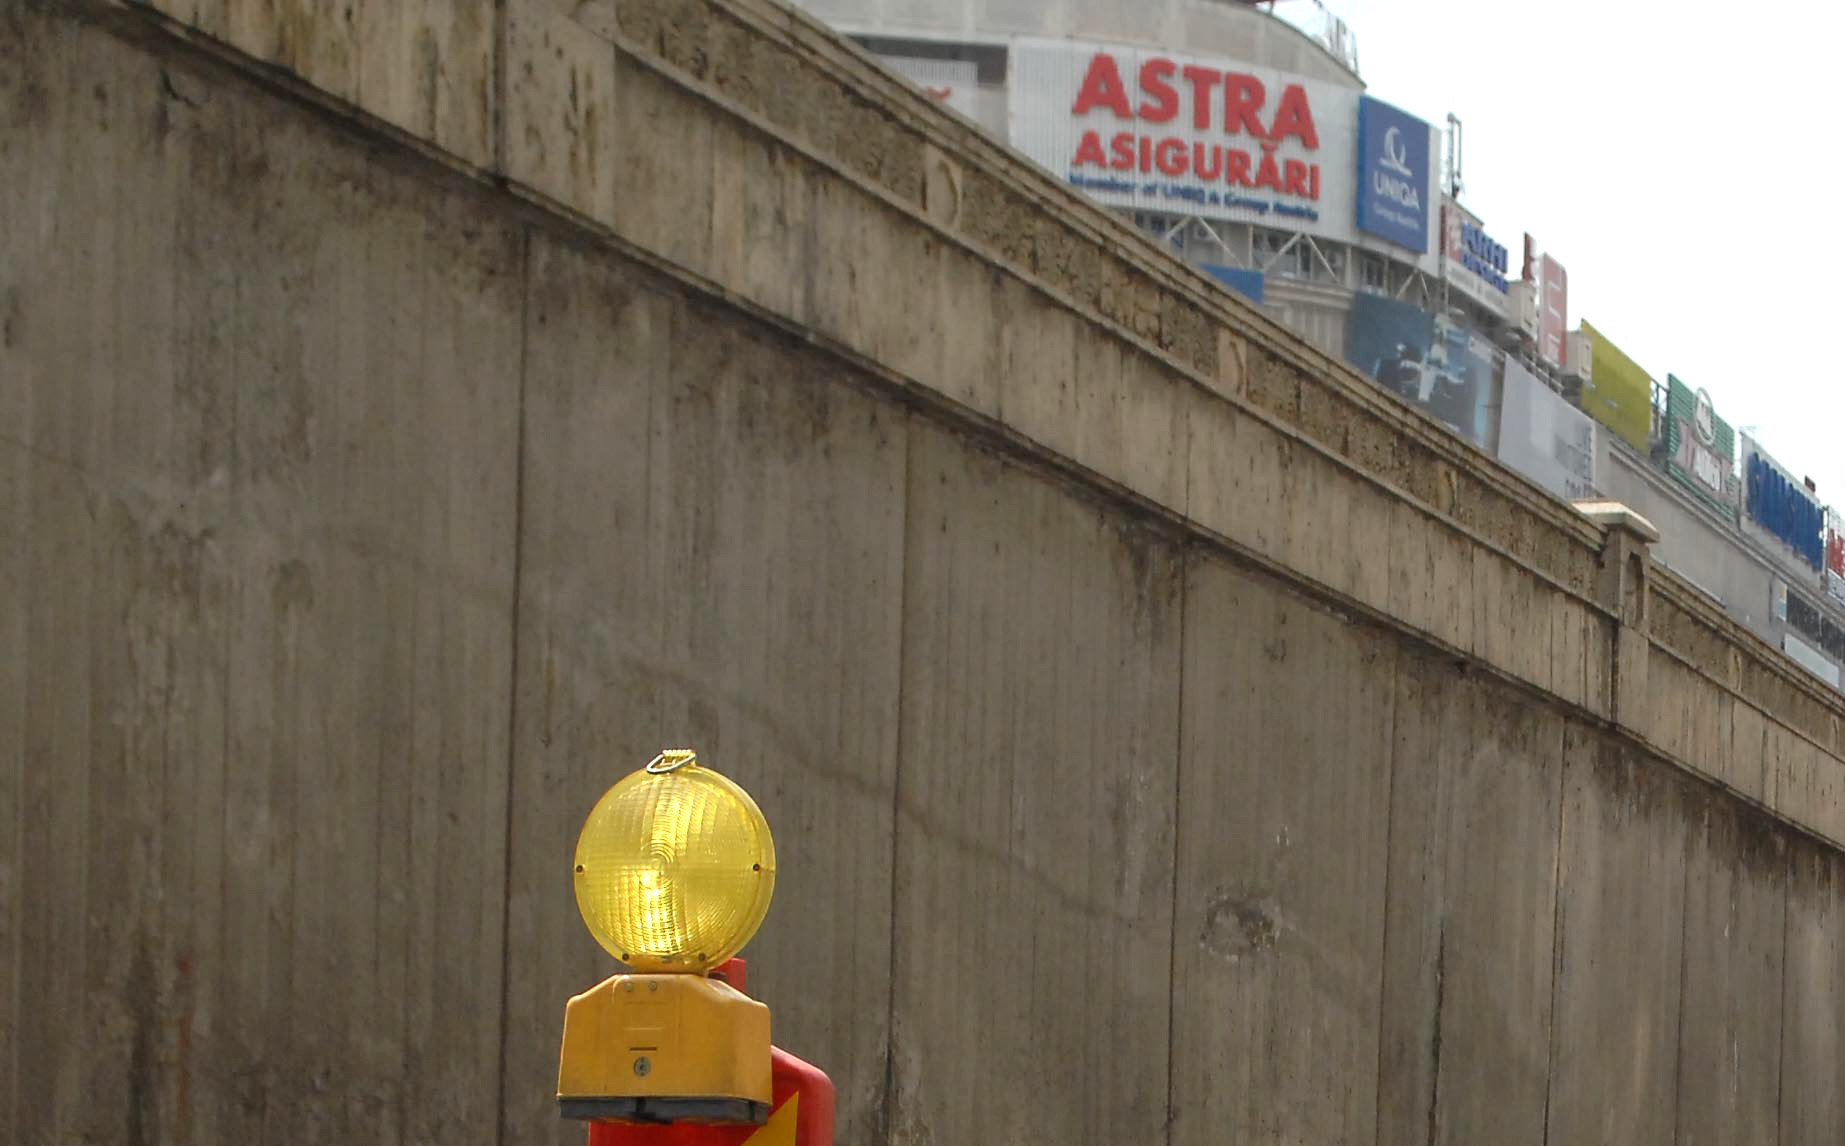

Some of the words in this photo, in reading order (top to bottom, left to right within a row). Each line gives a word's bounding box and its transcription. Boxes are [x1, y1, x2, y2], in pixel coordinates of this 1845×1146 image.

[1072, 53, 1319, 151] ASTRA
[1072, 130, 1320, 202] ASIGURĂRI
[1374, 171, 1420, 209] UNIQA
